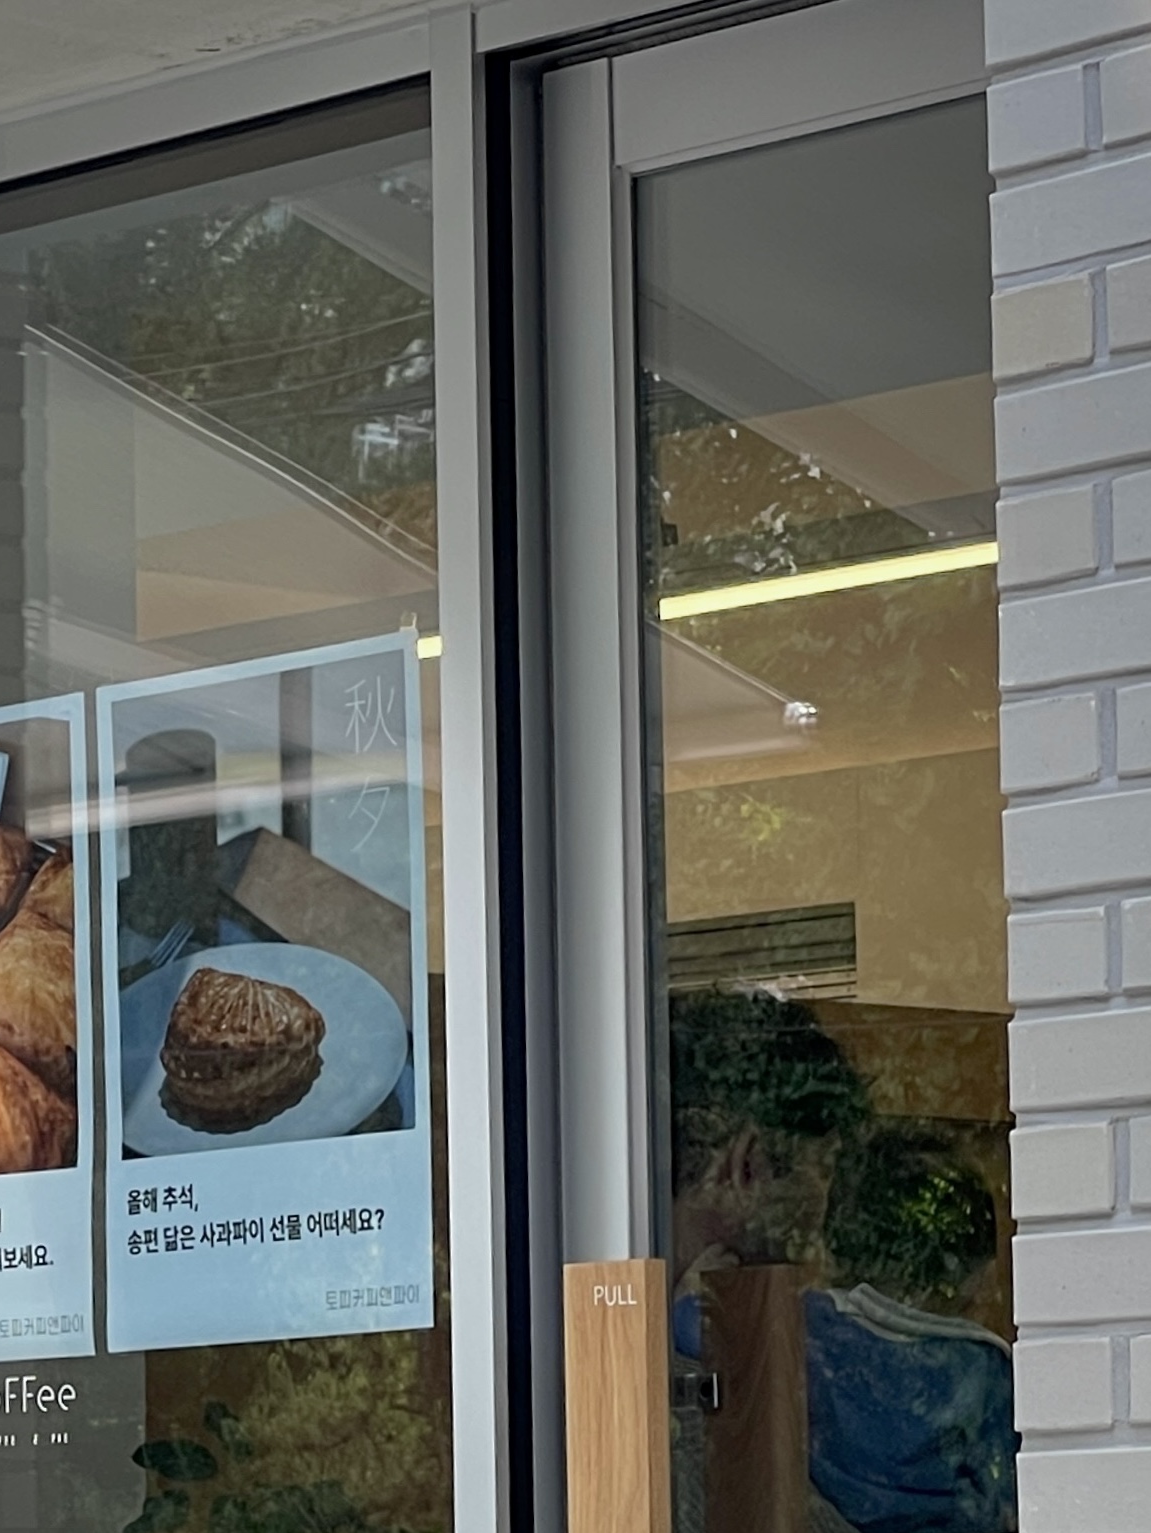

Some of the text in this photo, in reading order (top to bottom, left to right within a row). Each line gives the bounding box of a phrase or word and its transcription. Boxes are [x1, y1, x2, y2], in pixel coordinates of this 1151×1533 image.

[127, 1184, 198, 1216] 올해 추석,
[127, 1208, 385, 1255] 송편 닮은 사과파이 선물 어떠세요?
[325, 1284, 420, 1310] 토피커피앤파이
[593, 1284, 637, 1306] PULL
[0, 1314, 84, 1338] 토피커피앤파이
